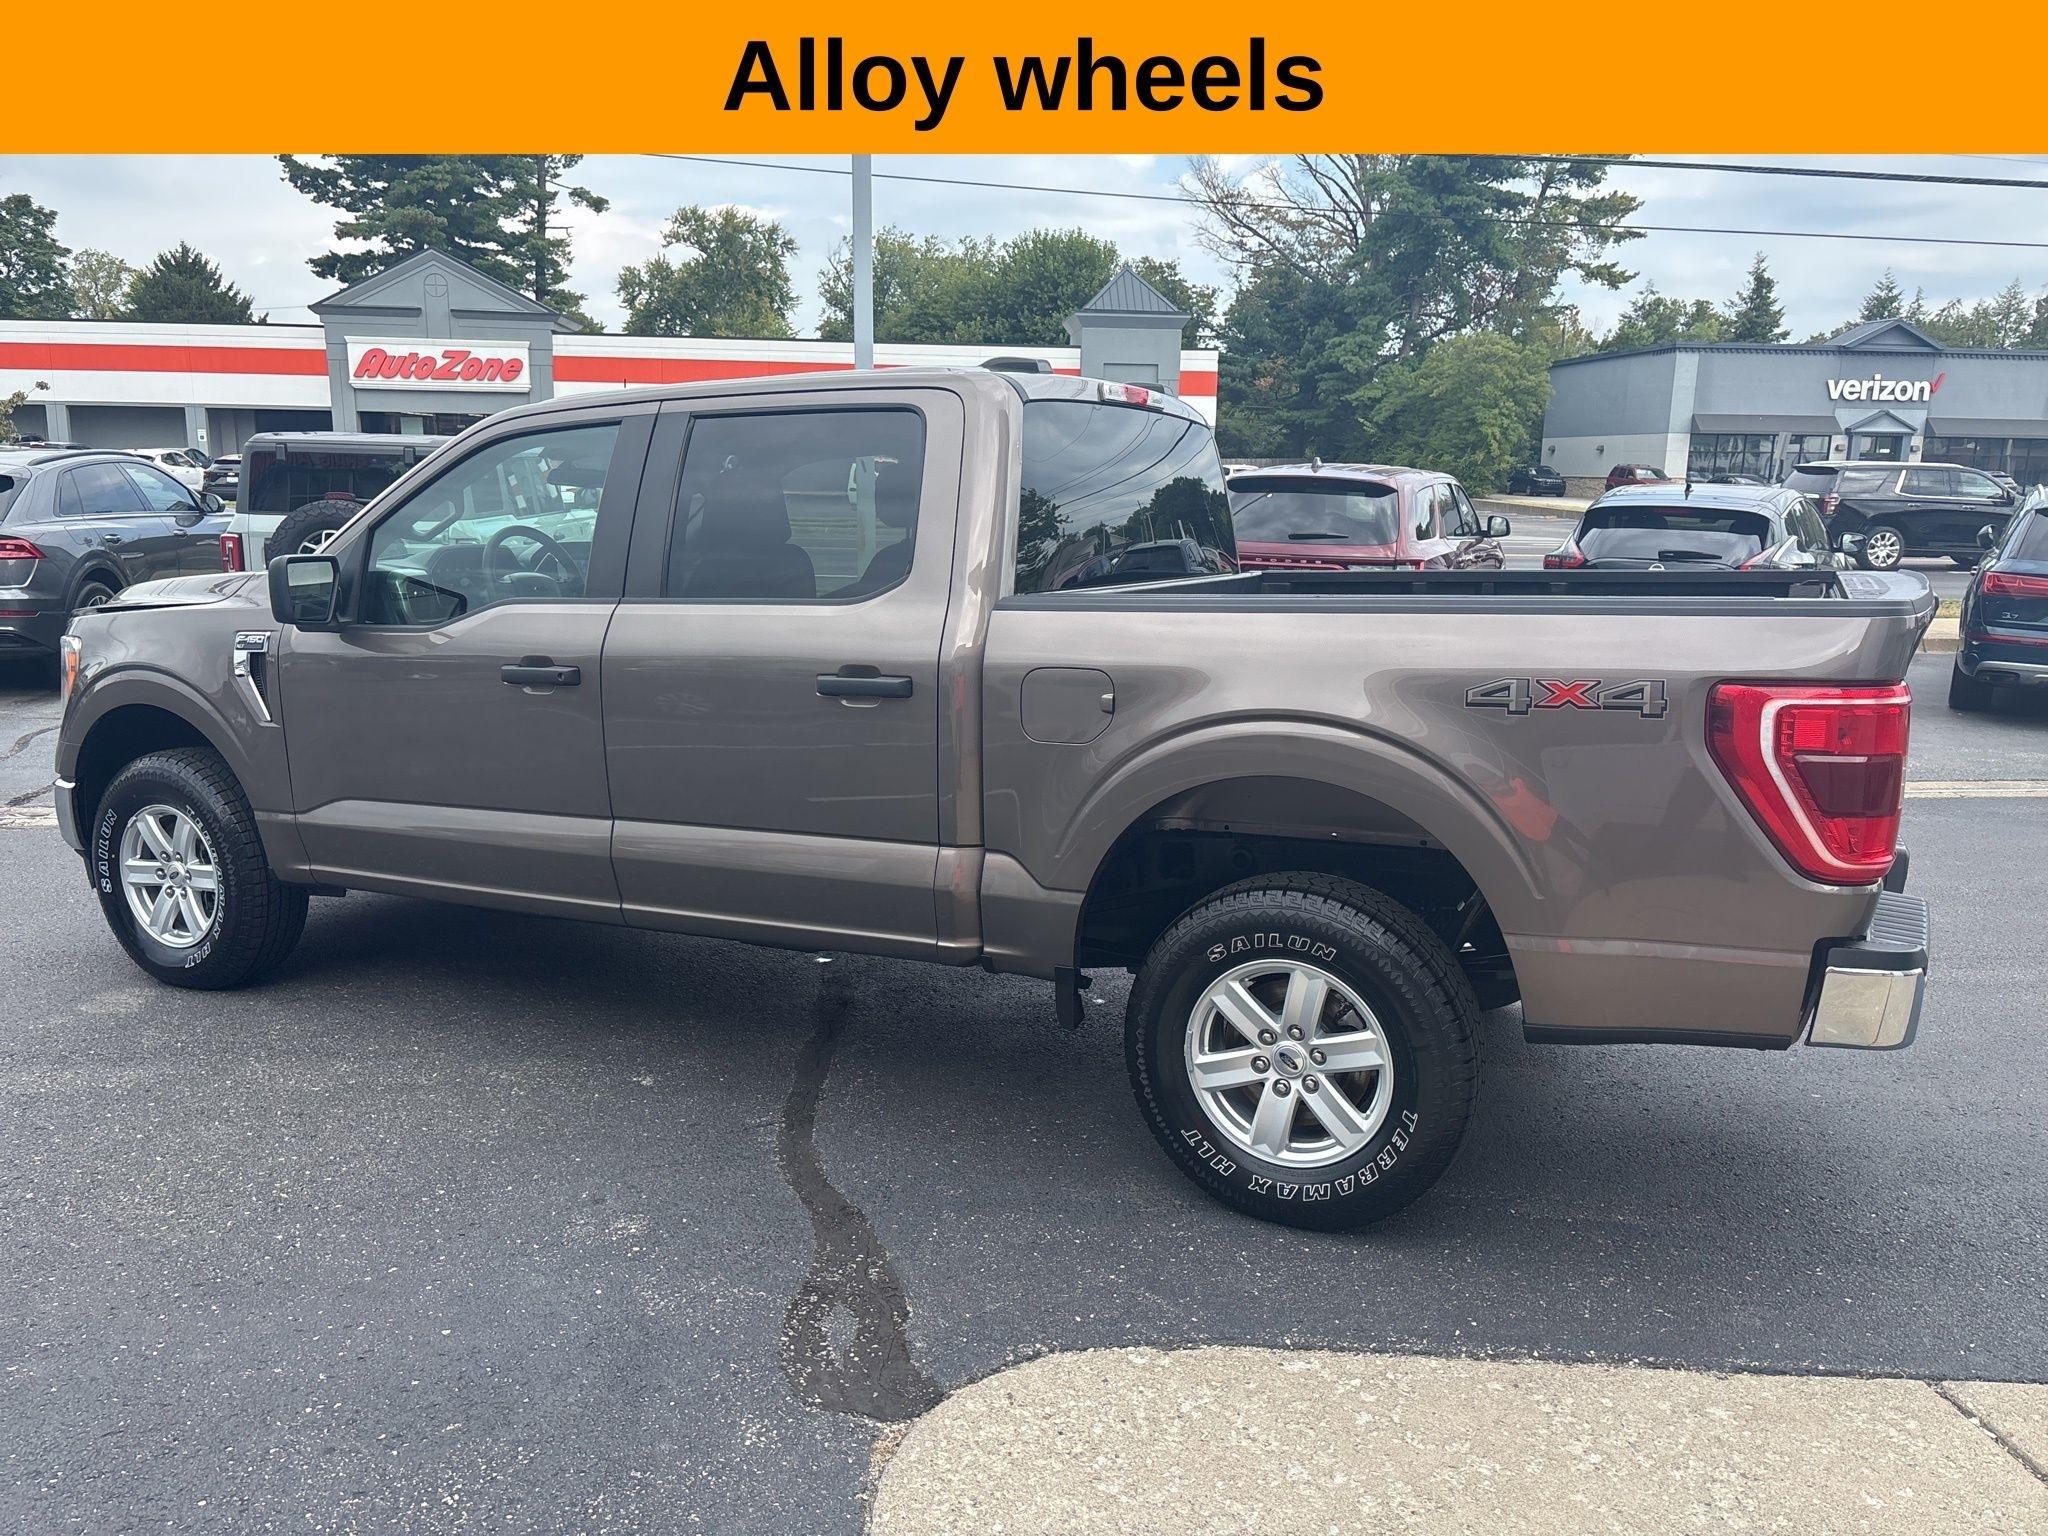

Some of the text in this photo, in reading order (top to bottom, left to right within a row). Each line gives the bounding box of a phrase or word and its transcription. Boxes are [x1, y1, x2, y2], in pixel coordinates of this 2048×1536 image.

[353, 347, 523, 382] AutoZone
[1827, 373, 1931, 401] verizon
[236, 635, 265, 643] F-150
[98, 808, 118, 893] SAILUN
[185, 942, 211, 969] HLT
[1207, 933, 1337, 963] SAILUN
[1181, 1110, 1419, 1202] TERRAMAX HLT
